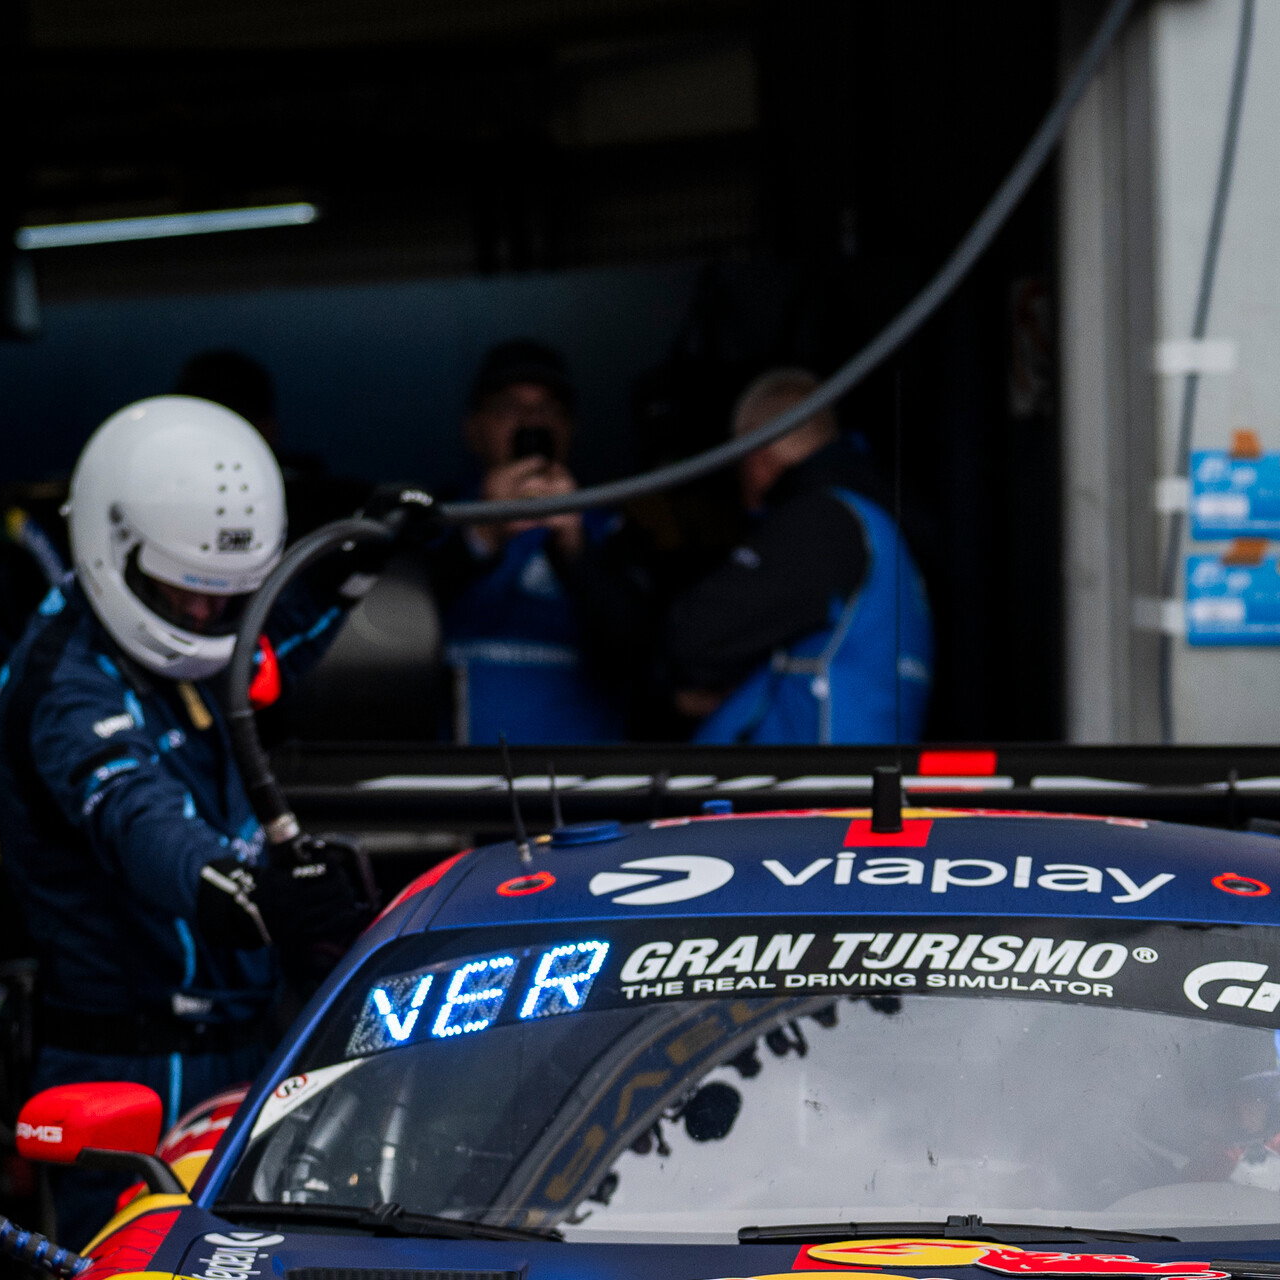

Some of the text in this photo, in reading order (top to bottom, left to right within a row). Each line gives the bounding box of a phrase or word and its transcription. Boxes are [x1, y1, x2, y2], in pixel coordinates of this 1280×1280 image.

[762, 851, 1176, 903] viaplay
[620, 932, 815, 984] GRAN
[373, 940, 610, 1042] VER
[621, 971, 1113, 1000] THE REAL DRIVING SIMULATOR
